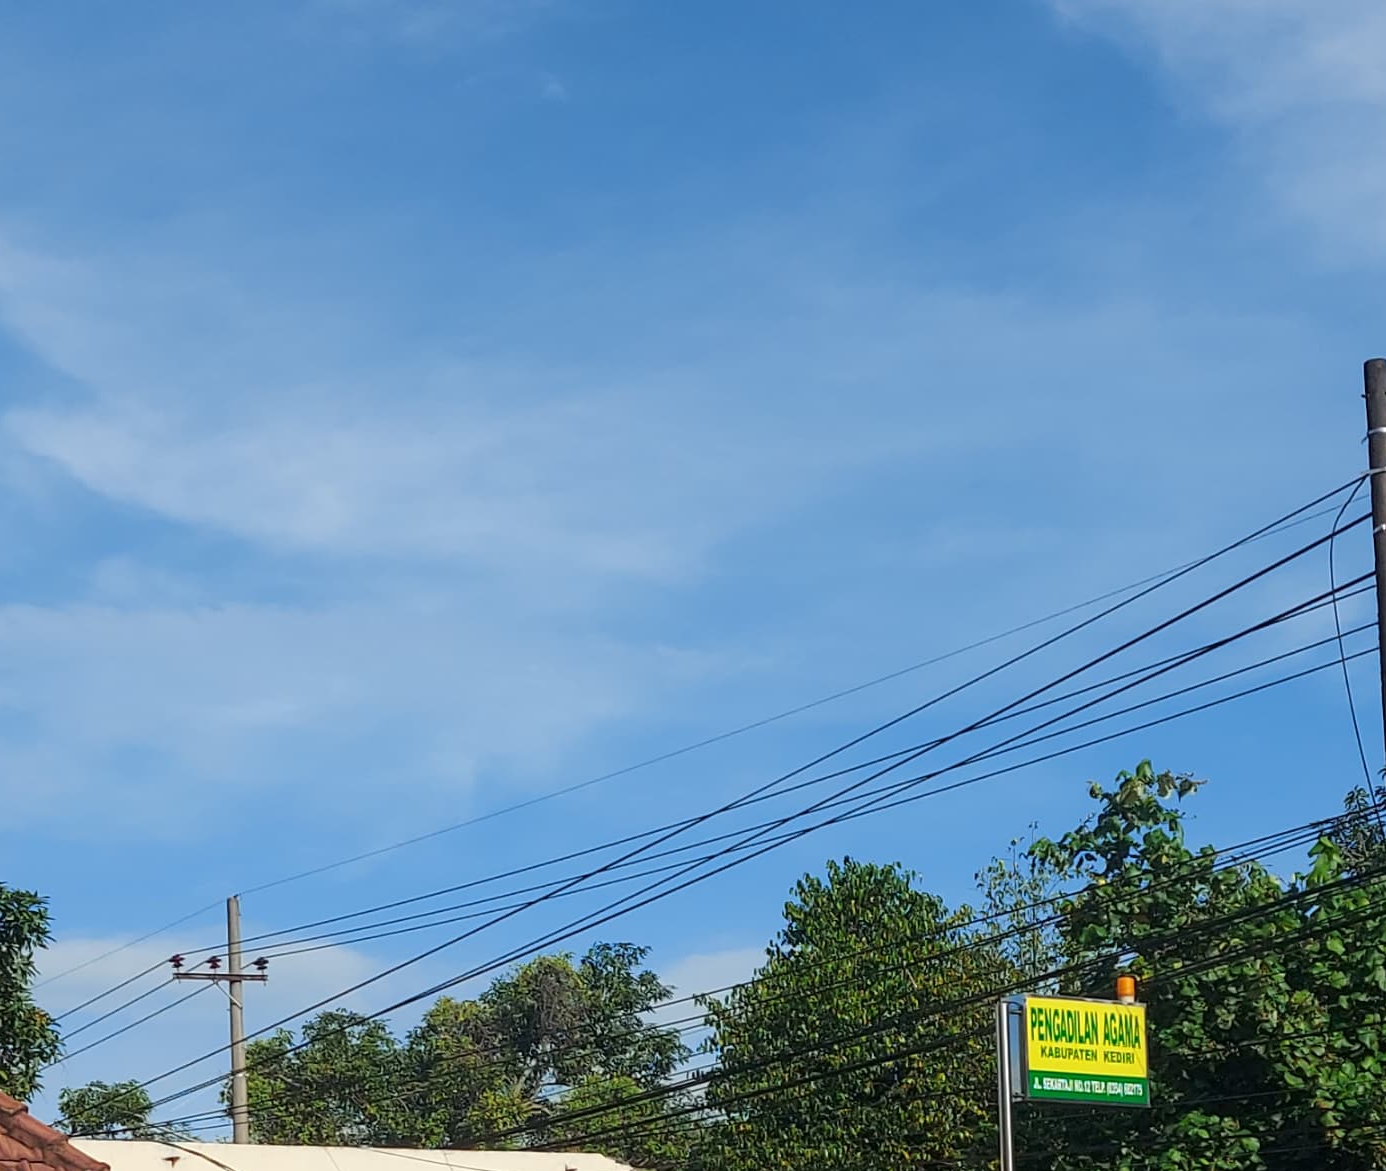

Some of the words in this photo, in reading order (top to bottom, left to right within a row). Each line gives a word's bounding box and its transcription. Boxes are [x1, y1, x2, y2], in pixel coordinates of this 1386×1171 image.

[1030, 1007, 1099, 1046] PENGADILAN
[1103, 1012, 1141, 1049] AGAMA
[1040, 1046, 1098, 1062] KABUPATEN
[1103, 1051, 1135, 1064] KEDIRI
